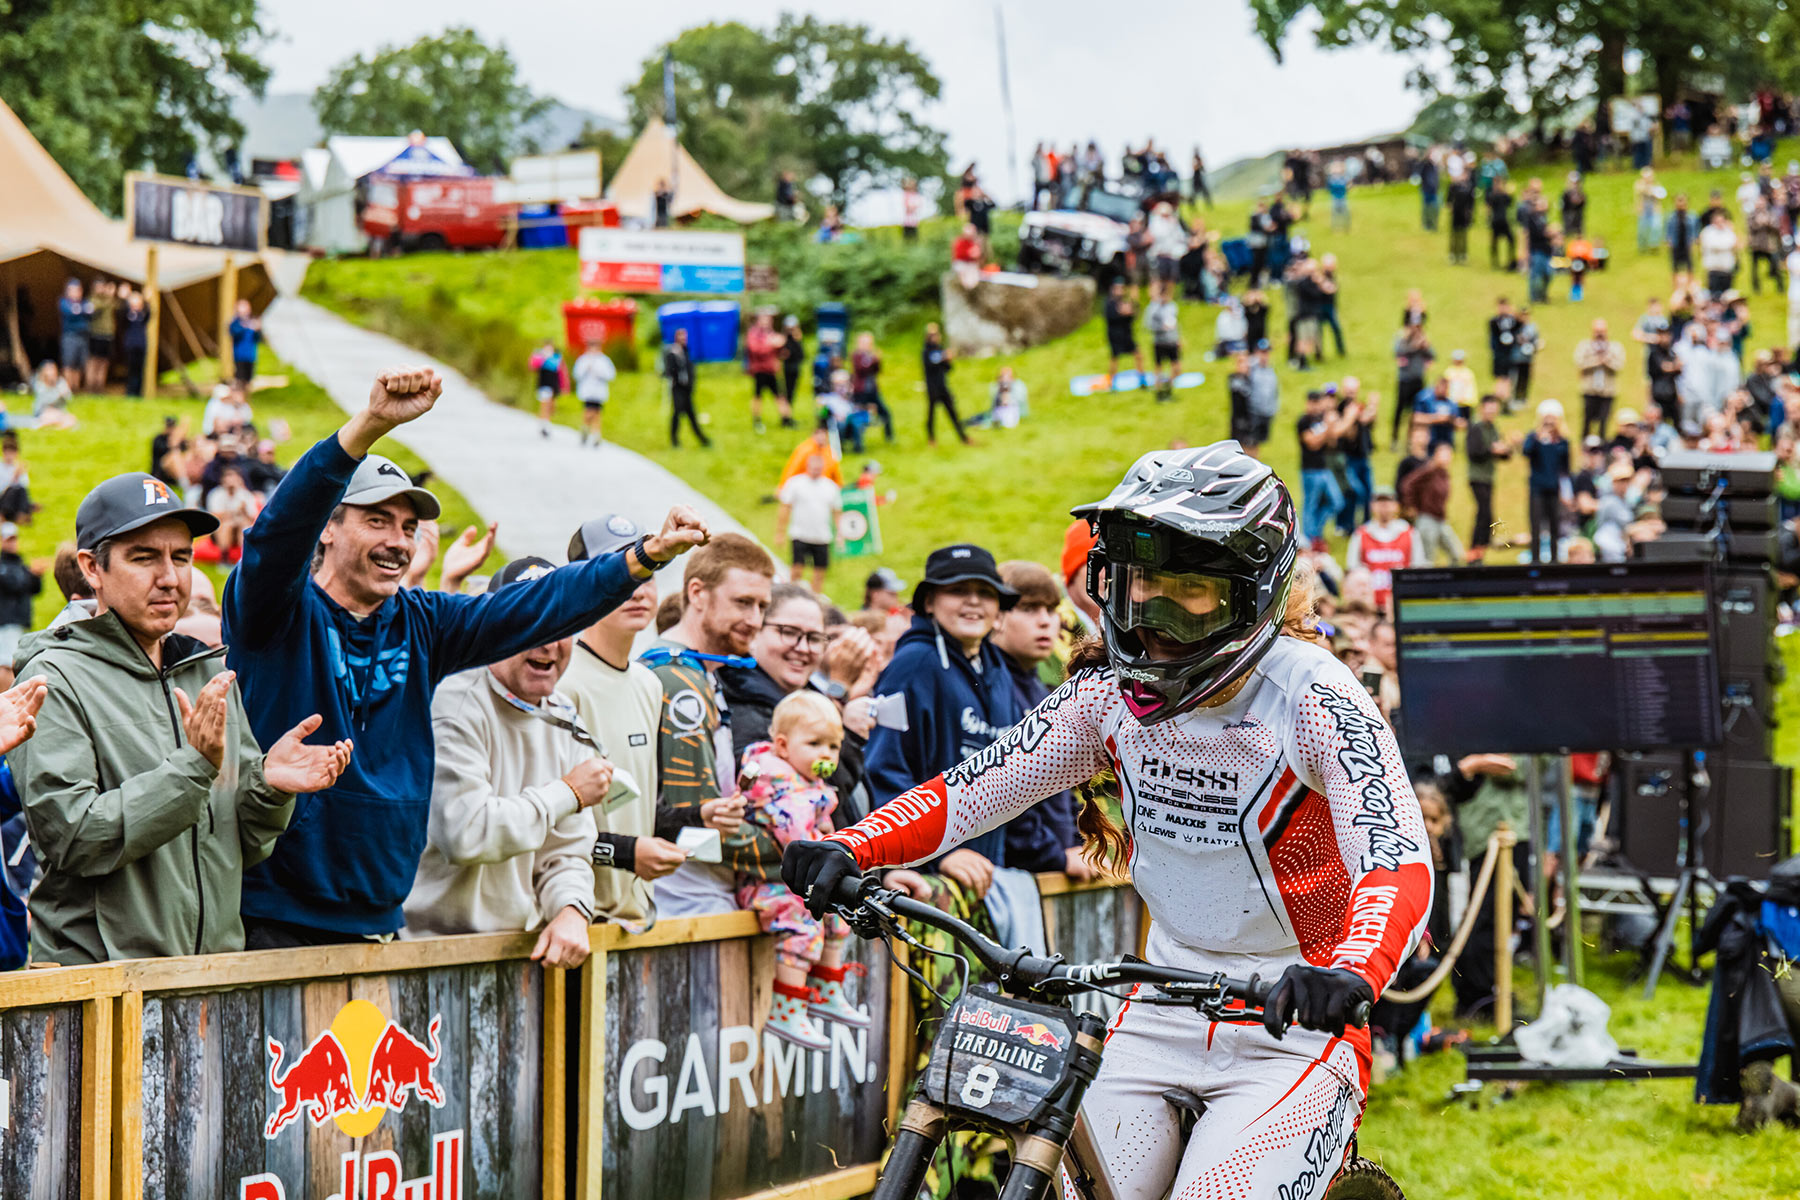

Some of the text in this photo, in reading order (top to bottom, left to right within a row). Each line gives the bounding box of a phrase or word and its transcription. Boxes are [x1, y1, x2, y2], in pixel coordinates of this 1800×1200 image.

[172, 189, 223, 245] BAR
[1139, 779, 1237, 806] INTENSE
[1141, 792, 1235, 815] FACTORY RACING
[1353, 779, 1399, 829] Lee
[1148, 825, 1176, 839] LEWIS
[1165, 813, 1207, 829] MAXXIS
[1196, 837, 1239, 847] PEATY'S
[960, 1064, 1000, 1109] 8
